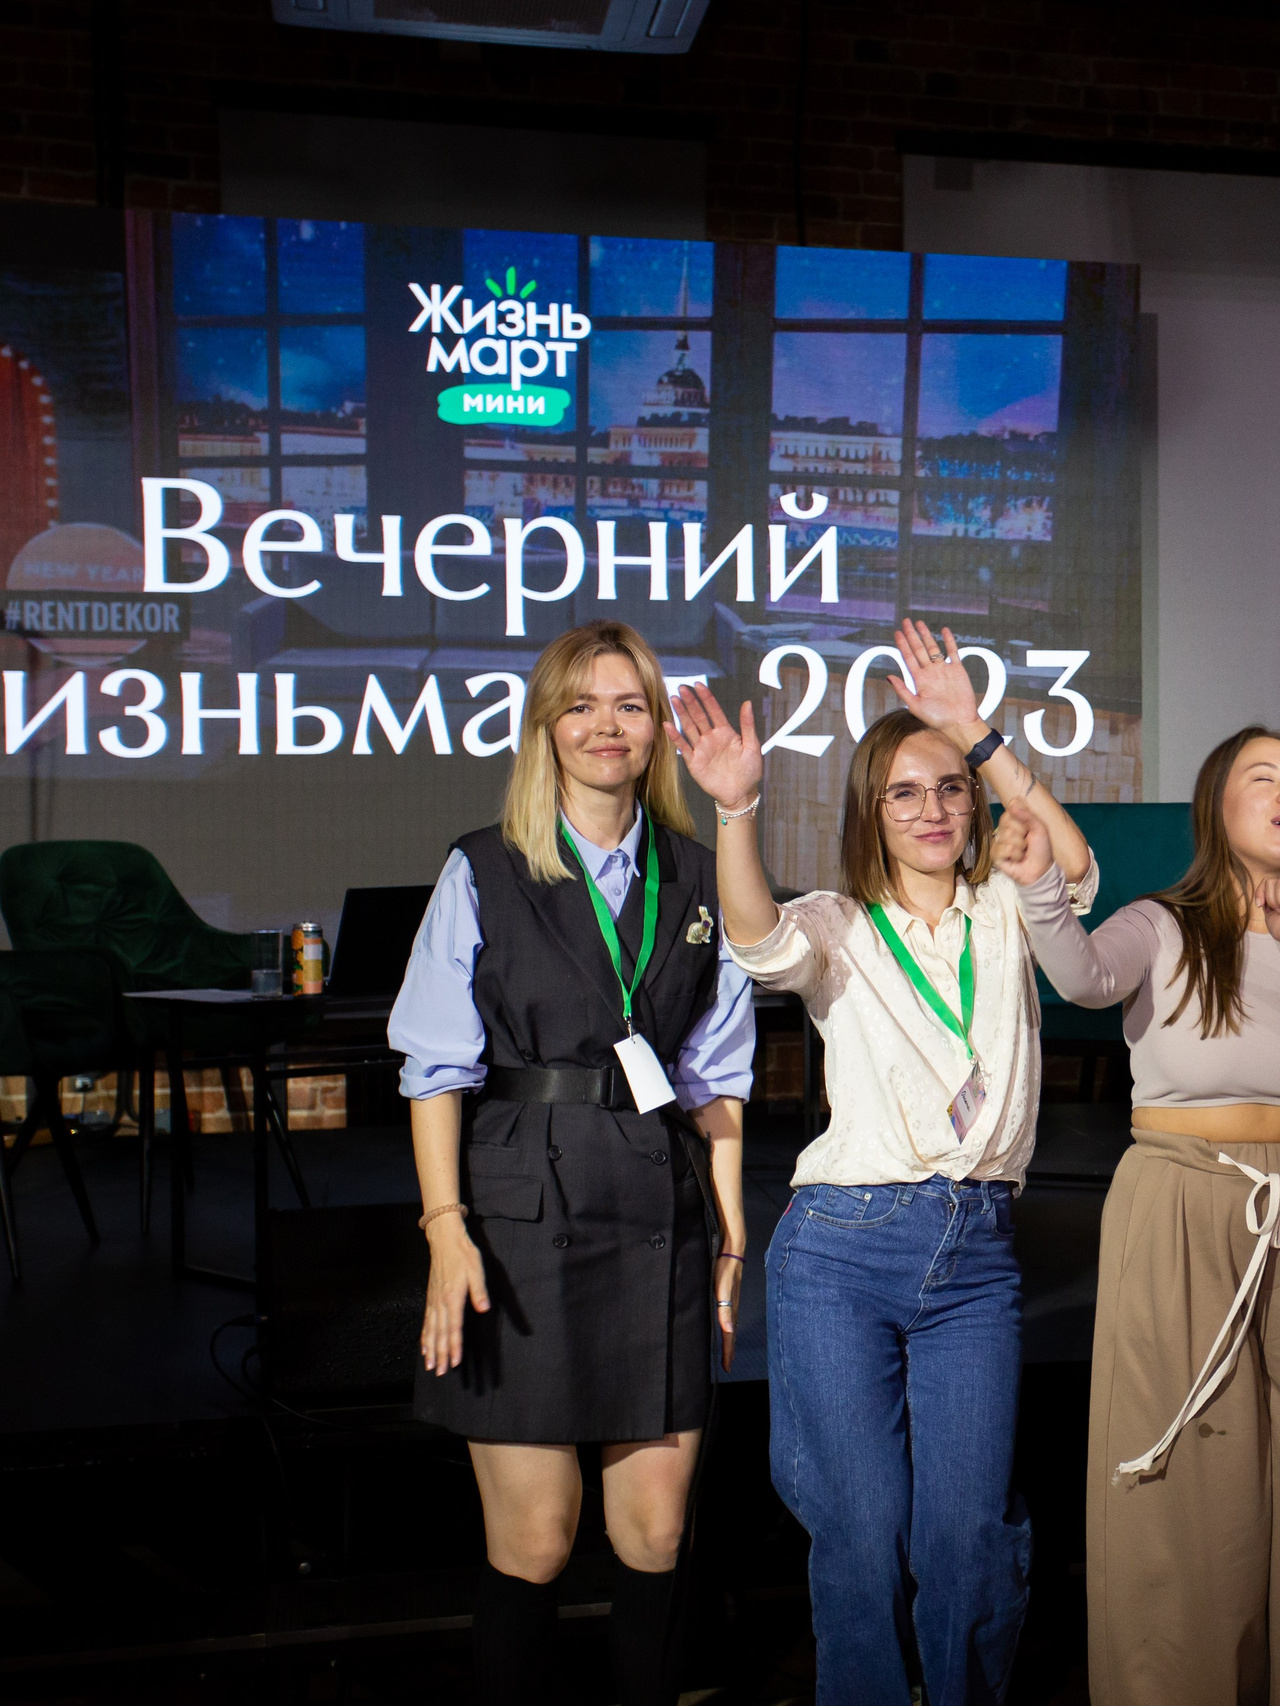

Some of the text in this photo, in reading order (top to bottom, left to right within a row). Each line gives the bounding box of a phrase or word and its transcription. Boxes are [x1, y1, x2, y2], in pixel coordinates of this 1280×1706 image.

[407, 282, 592, 340] Жизнь
[425, 335, 578, 391] март
[140, 476, 841, 638] Вечерний
[4, 599, 181, 634] #RENTDEKOR
[3, 644, 1095, 759] изньма 2023
